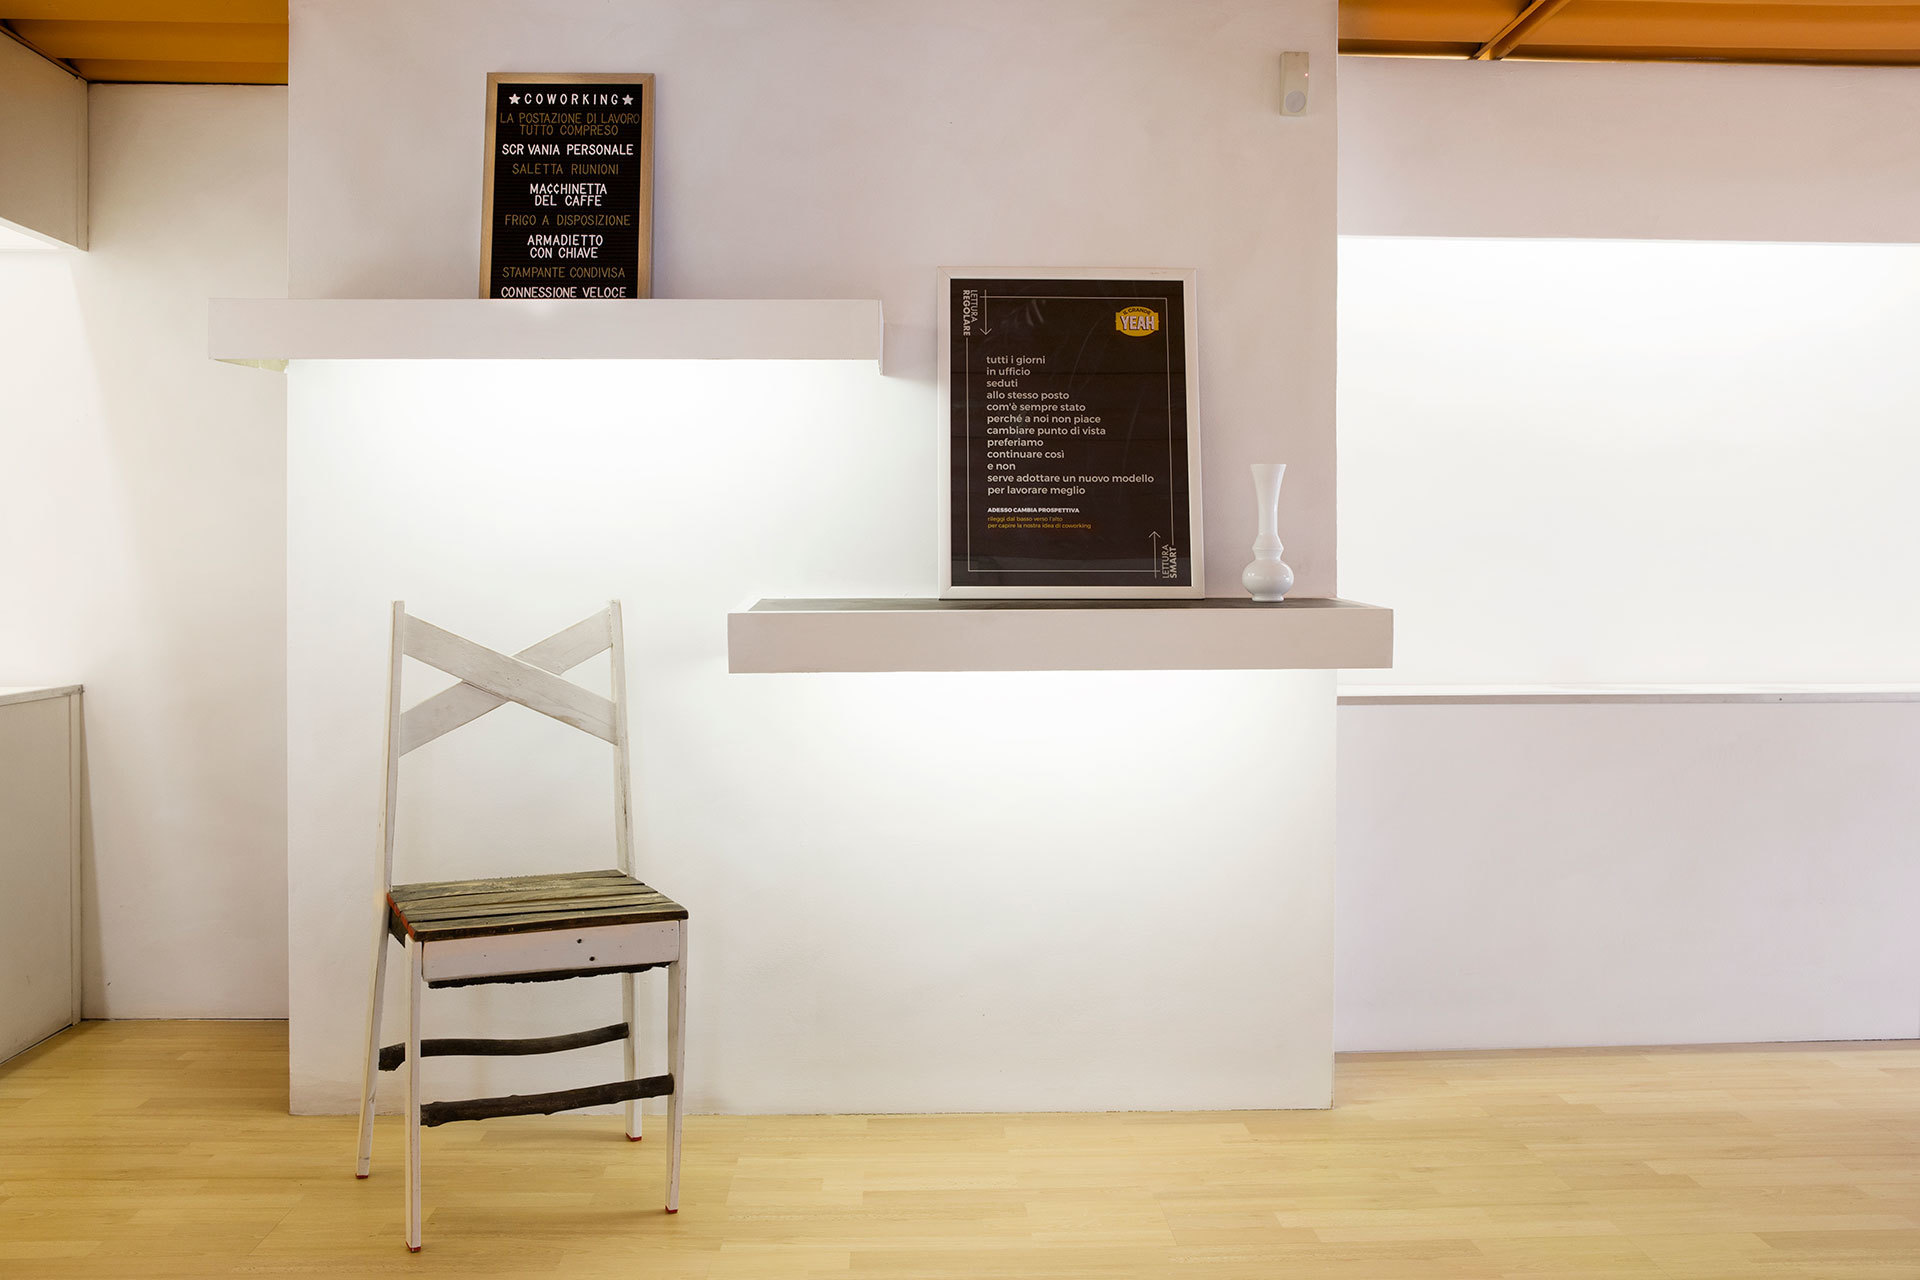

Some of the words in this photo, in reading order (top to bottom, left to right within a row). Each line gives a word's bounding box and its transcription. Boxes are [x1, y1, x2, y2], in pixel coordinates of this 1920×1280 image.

[524, 94, 618, 105] COWORKING
[500, 113, 514, 124] LA
[519, 113, 582, 124] POSTAZIONE
[587, 113, 597, 124] DI
[601, 113, 640, 124] LAVORO
[520, 125, 553, 135] TUTTO
[560, 125, 618, 136] COMPRESO
[567, 144, 634, 155] PERSONALE
[512, 164, 563, 175] SALETTA
[571, 164, 618, 175] RIUNIONI
[535, 195, 557, 206] DEL
[565, 195, 602, 206] CAFFE
[505, 215, 536, 225] FRIGO
[542, 215, 549, 225] A
[557, 215, 631, 226] DISPOSIZIONE
[527, 235, 603, 245] ARMADIETTO
[530, 247, 552, 258] CON
[558, 247, 598, 258] CHIAVE
[502, 267, 566, 278] STAMPANTE
[570, 267, 625, 278] CONDIVISA
[501, 287, 577, 298] CONNESSIONE
[582, 287, 626, 298] VELOCE
[1120, 316, 1154, 330] YEAH
[1016, 356, 1045, 366] giorni
[999, 367, 1030, 375] ufficio
[987, 391, 1005, 399] allo
[1041, 392, 1069, 401] posto
[987, 403, 1017, 411] com'è
[1020, 405, 1058, 413] sempre
[987, 415, 1022, 424] perché
[1034, 415, 1049, 423] noi
[1074, 415, 1101, 424] piace
[1038, 428, 1068, 436] punto
[988, 438, 1043, 448] preferiamo
[1045, 450, 1064, 458] così
[1017, 474, 1060, 482] adottare
[1112, 474, 1154, 482] modello
[988, 487, 1005, 496] per
[1008, 486, 1048, 494] lavorare
[1051, 486, 1085, 496] meglio
